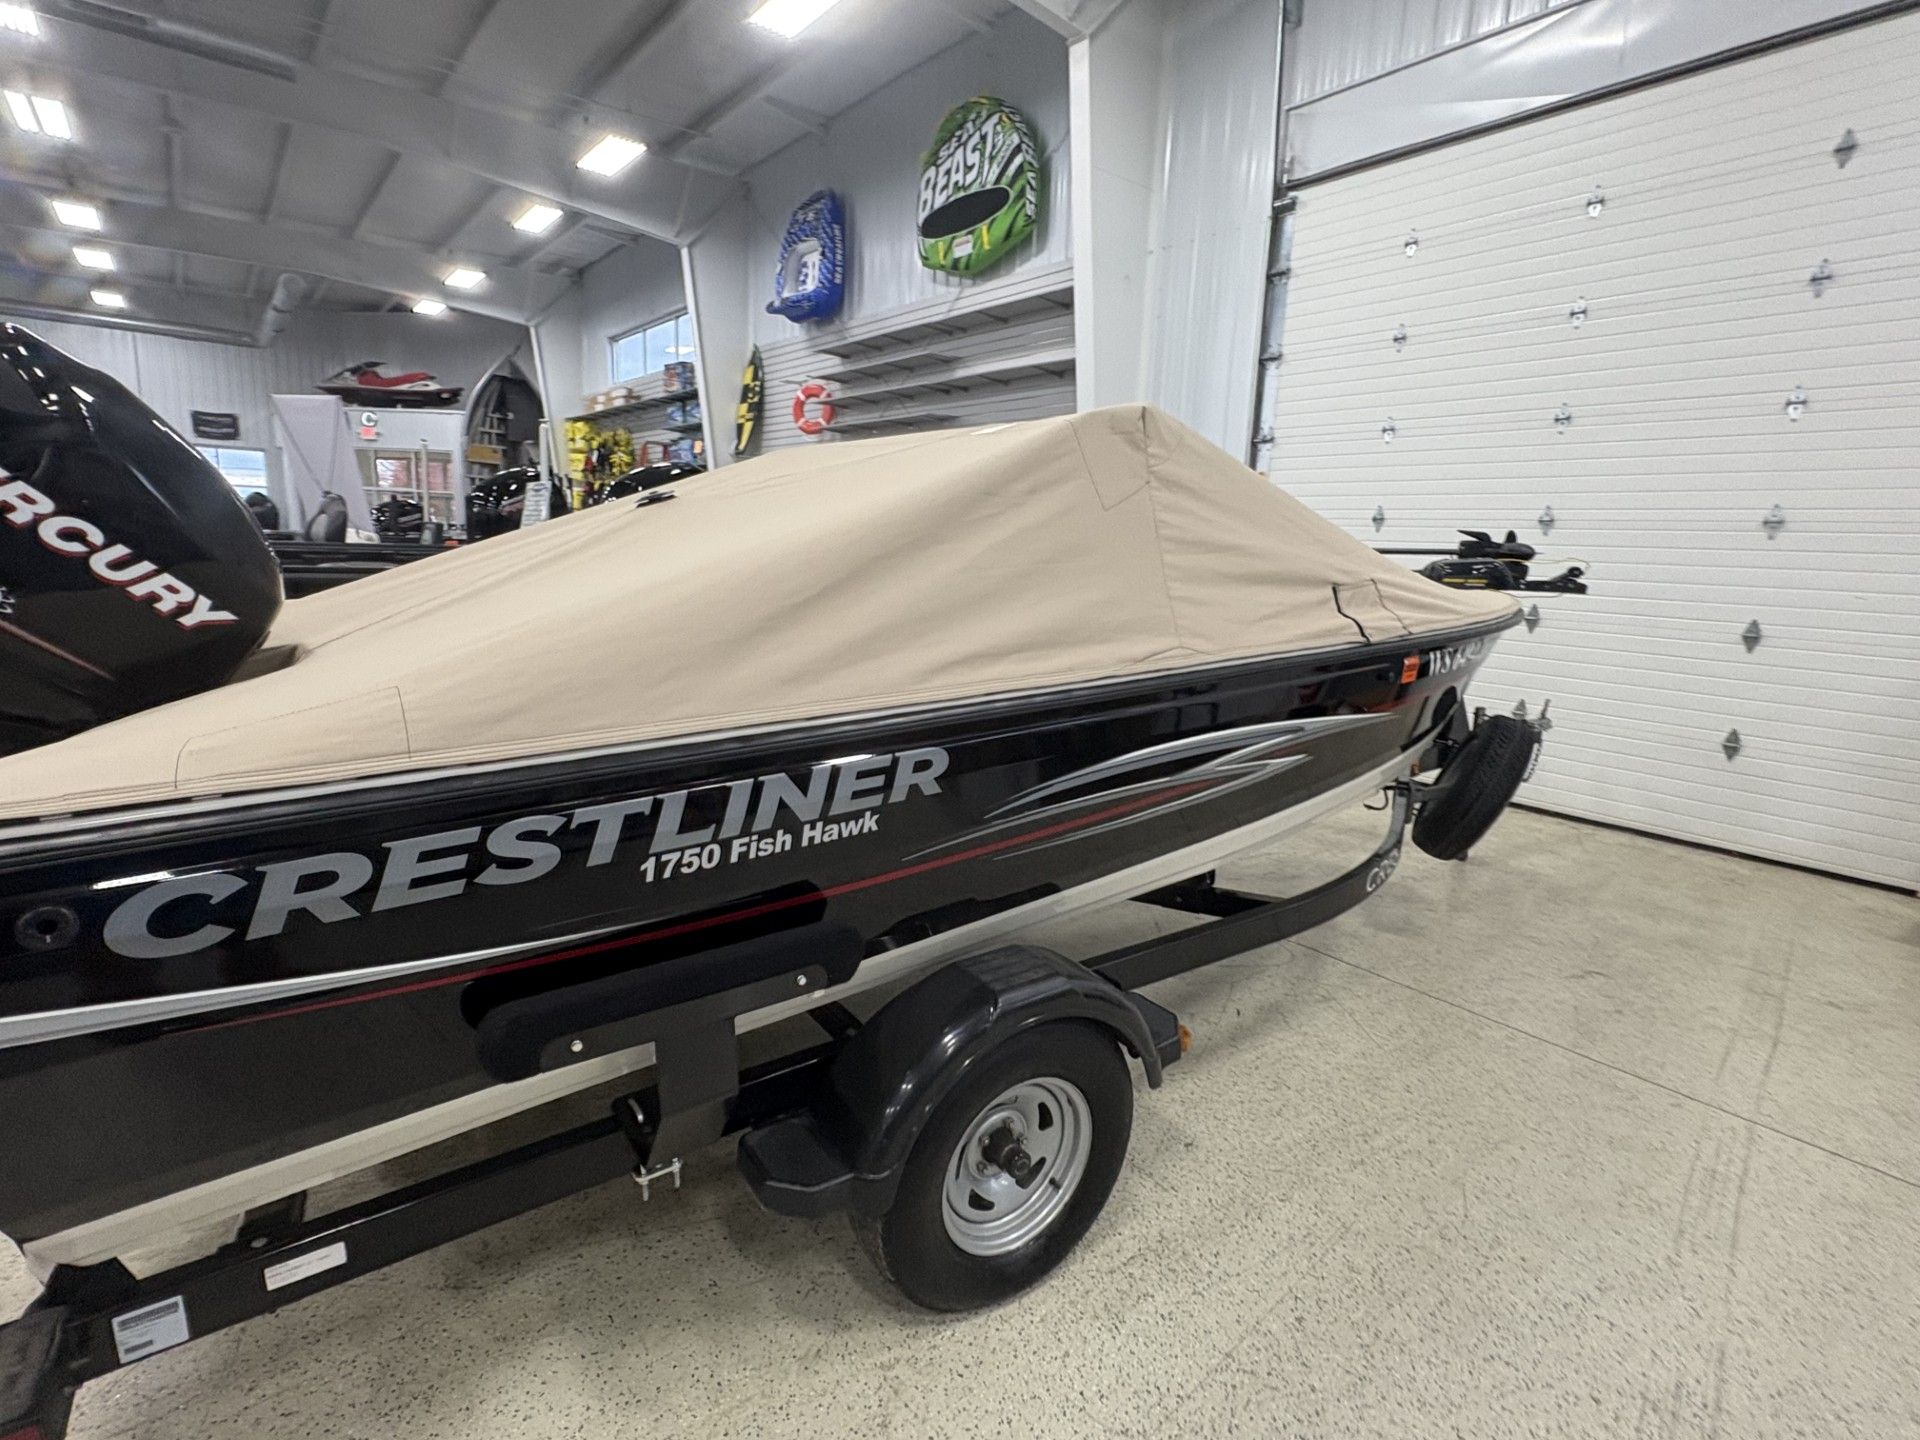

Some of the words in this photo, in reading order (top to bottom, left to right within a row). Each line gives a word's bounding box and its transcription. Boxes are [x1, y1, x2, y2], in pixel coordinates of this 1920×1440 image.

[917, 112, 1004, 226] BEAST
[103, 746, 951, 959] CRESTLINER
[639, 844, 720, 884] 1750
[729, 828, 793, 865] Fish
[800, 811, 879, 846] Hawk
